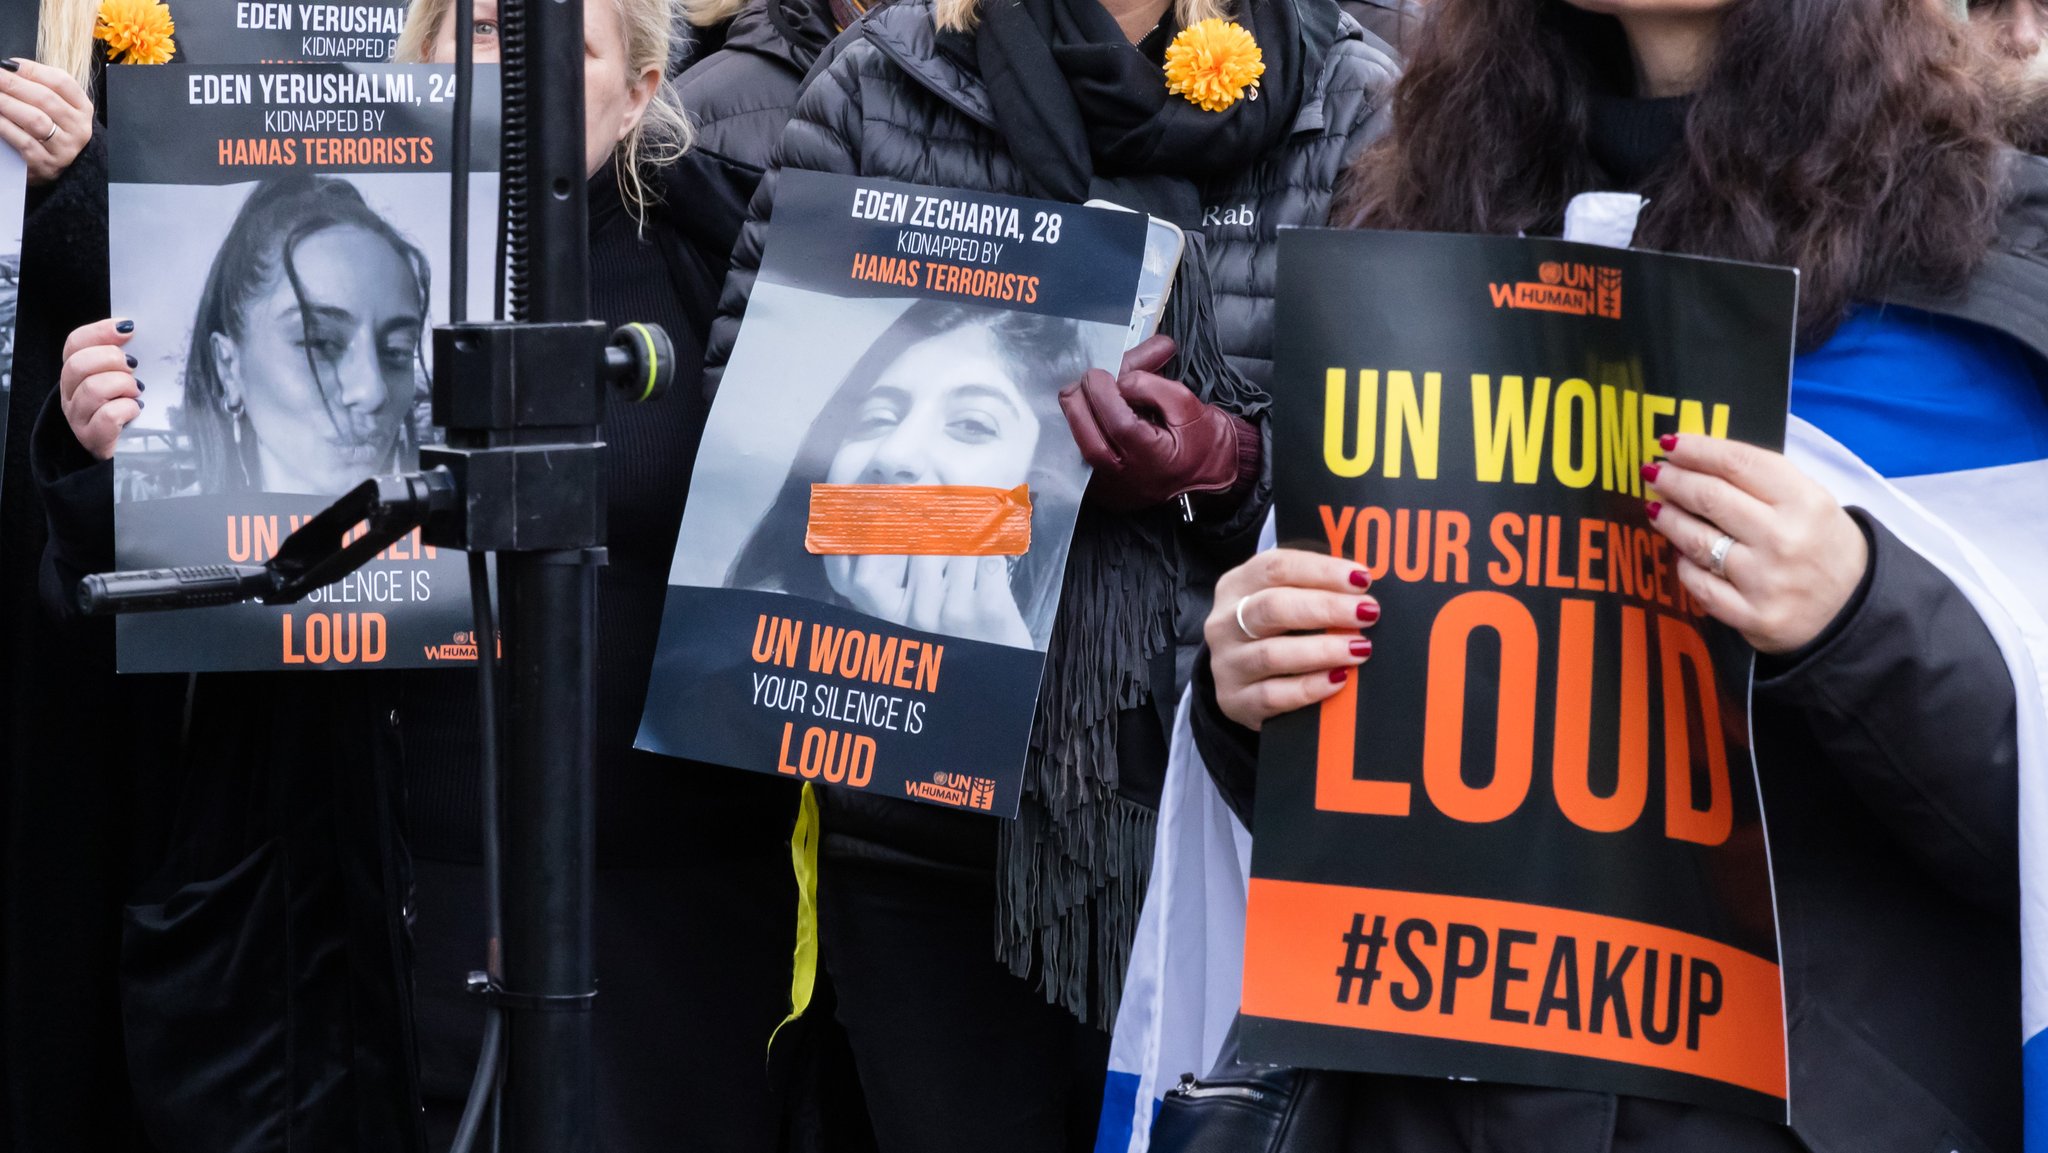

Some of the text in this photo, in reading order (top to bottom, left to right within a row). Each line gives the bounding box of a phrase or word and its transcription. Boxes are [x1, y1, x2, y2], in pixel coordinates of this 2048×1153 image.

[236, 2, 404, 34] EDEN YERUSHAL
[302, 36, 397, 59] KIDNAPPED B
[188, 73, 456, 106] EDEN YERUSHALMI, 24
[265, 109, 385, 132] KIDNAPPED BY
[218, 137, 434, 165] HAMAS TERRORISTS
[851, 188, 1062, 244] EDEN ZECHARYA, 28
[1201, 203, 1254, 227] Rab
[896, 230, 1003, 265] KIDNAPPED BY
[851, 253, 1040, 304] HAMAS TERRORISTS
[1563, 261, 1595, 289] UN
[1323, 367, 1442, 480] UN
[227, 515, 280, 562] UN
[1318, 504, 1471, 583] YOUR
[1487, 511, 1673, 607] SILENCE
[411, 569, 431, 602] IS
[282, 611, 388, 664] LOUD
[751, 614, 945, 694] UN WOMEN
[752, 672, 926, 734] YOUR SILENCE IS
[1315, 589, 1734, 847] LOUD
[777, 721, 877, 789] LOUD
[947, 772, 972, 791] UN
[1335, 912, 1725, 1052] #SPEAKUP
